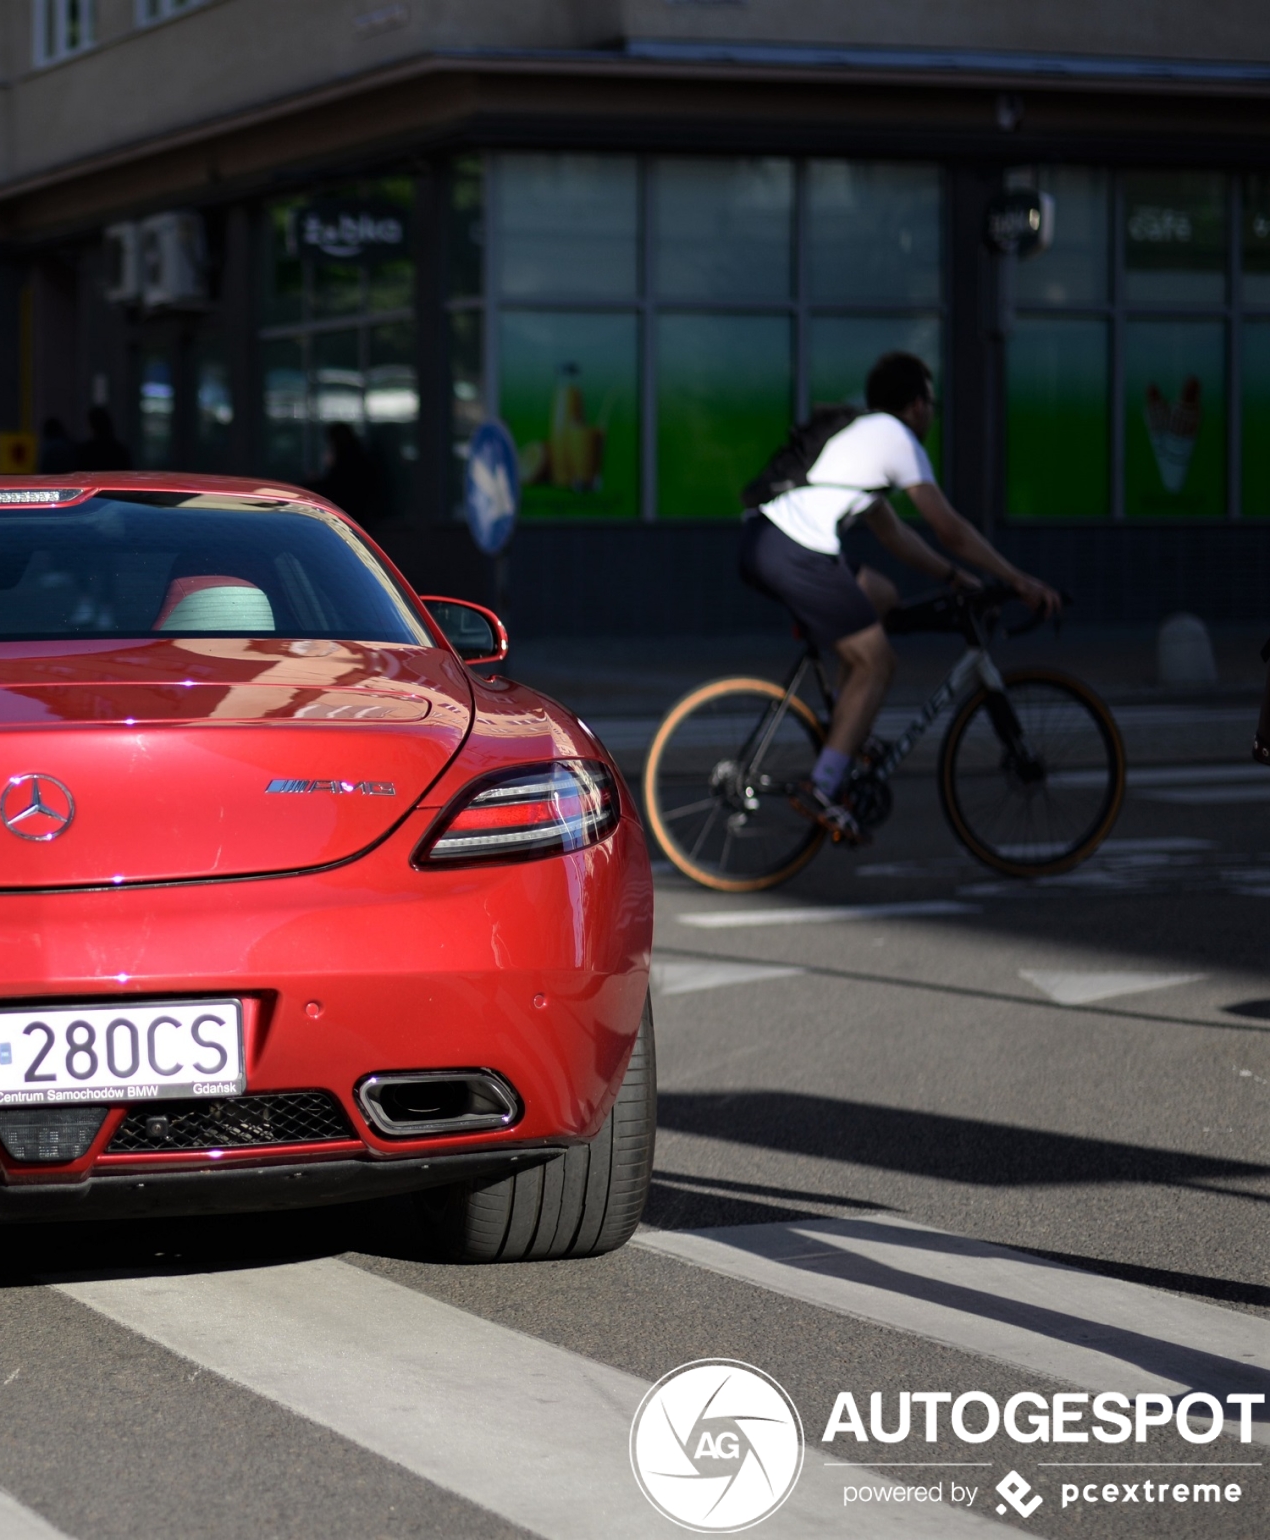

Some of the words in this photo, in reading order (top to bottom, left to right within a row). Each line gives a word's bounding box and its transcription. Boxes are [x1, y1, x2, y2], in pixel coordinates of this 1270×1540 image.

[309, 779, 396, 796] AMG
[22, 1013, 228, 1082] 280CS
[47, 1087, 124, 1101] Samochodów
[127, 1085, 159, 1098] BMW
[192, 1082, 237, 1095] Gdańsk
